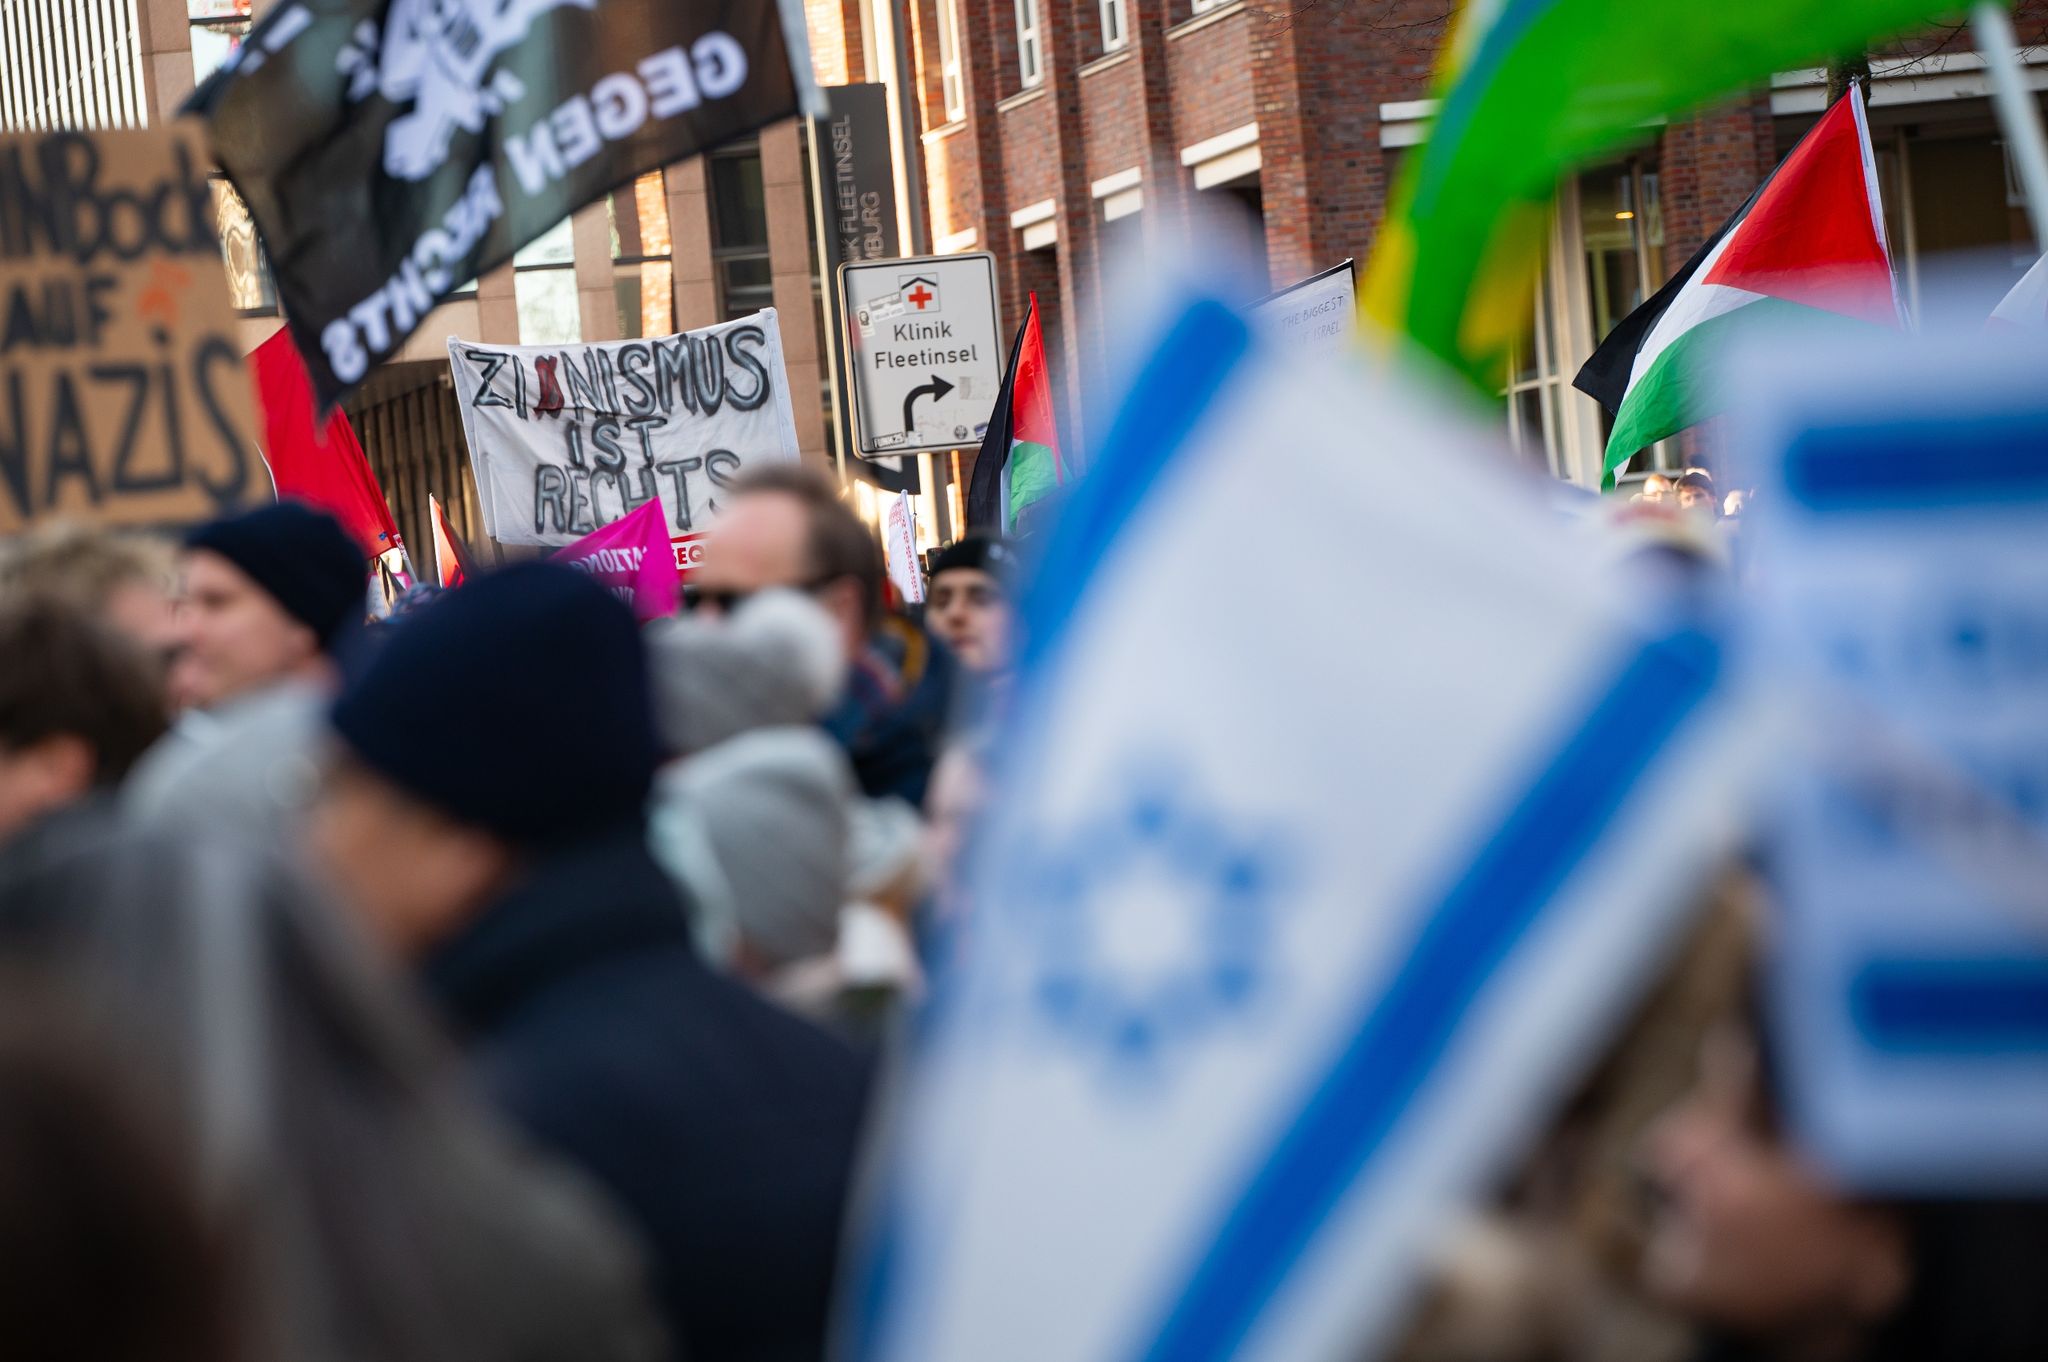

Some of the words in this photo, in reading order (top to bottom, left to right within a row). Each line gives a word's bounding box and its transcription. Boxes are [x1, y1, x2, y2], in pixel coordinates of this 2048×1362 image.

[832, 113, 859, 234] FLEETINSEL
[893, 321, 952, 341] Klinik
[874, 344, 978, 369] Fleetinsel
[566, 415, 667, 473] IST
